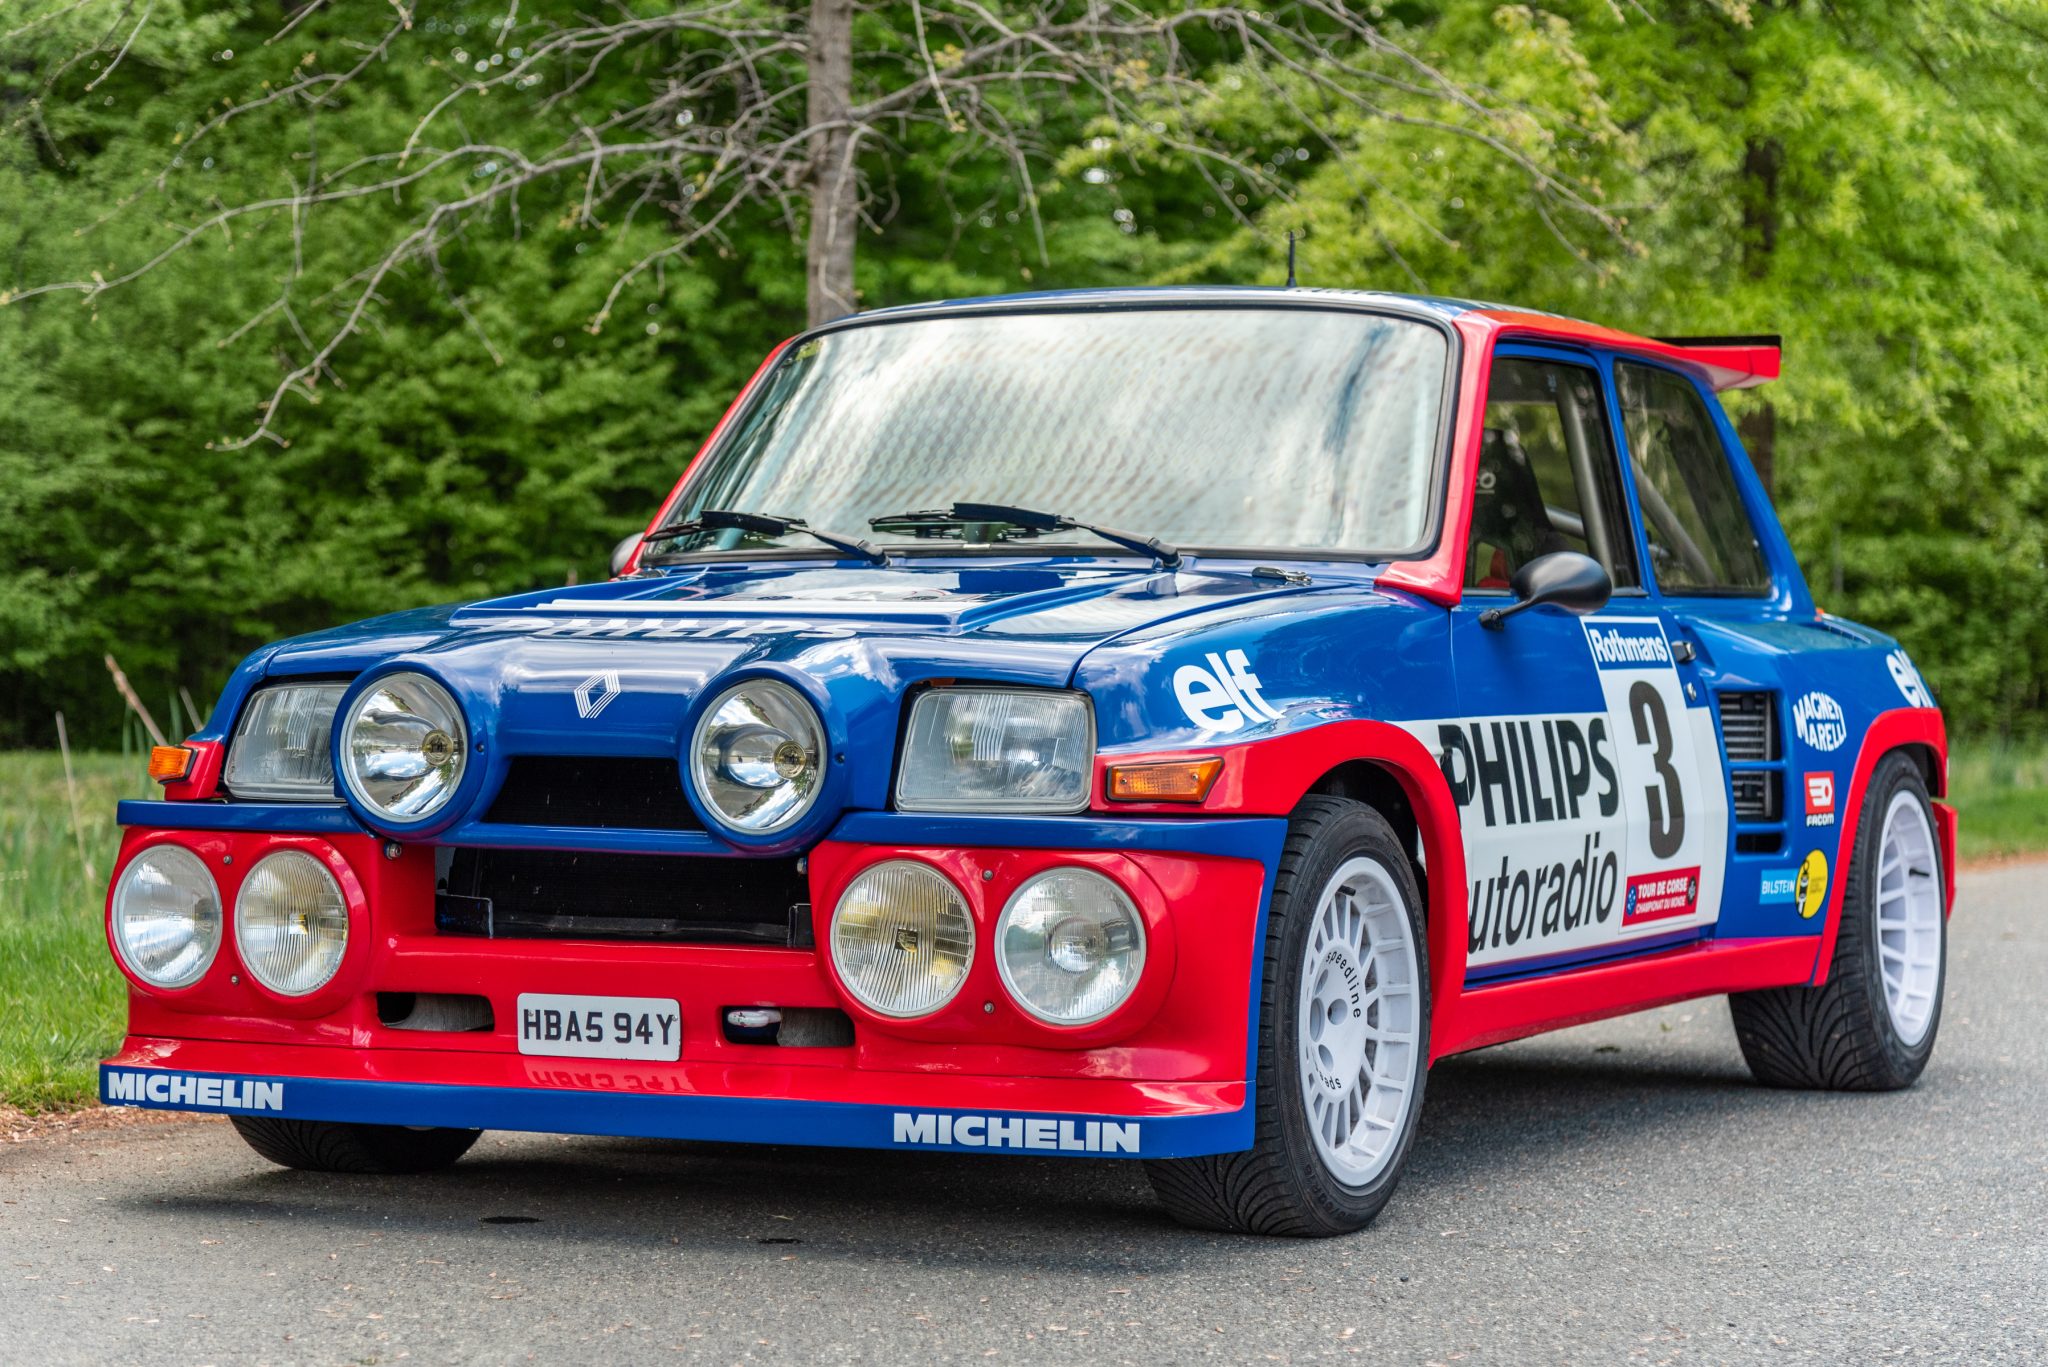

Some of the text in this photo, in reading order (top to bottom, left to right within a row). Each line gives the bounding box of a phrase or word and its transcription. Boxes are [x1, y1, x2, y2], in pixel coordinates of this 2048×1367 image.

[1588, 628, 1668, 662] Rothmans
[1173, 648, 1286, 733] elf
[1886, 648, 1933, 708] elf
[1438, 717, 1619, 831] PHILIPS
[1629, 680, 1685, 859] 3
[1806, 813, 1834, 827] FACOM
[1468, 831, 1618, 954] utoradio
[1638, 877, 1688, 899] TOUR DE CORSE
[1671, 895, 1686, 908] MONDE
[1762, 879, 1795, 895] BILSTEIN
[1326, 951, 1361, 1018] speedline
[523, 1009, 674, 1045] HBA5 94Y
[108, 1072, 283, 1111] MICHELIN
[893, 1112, 1140, 1153] MICHELIN
